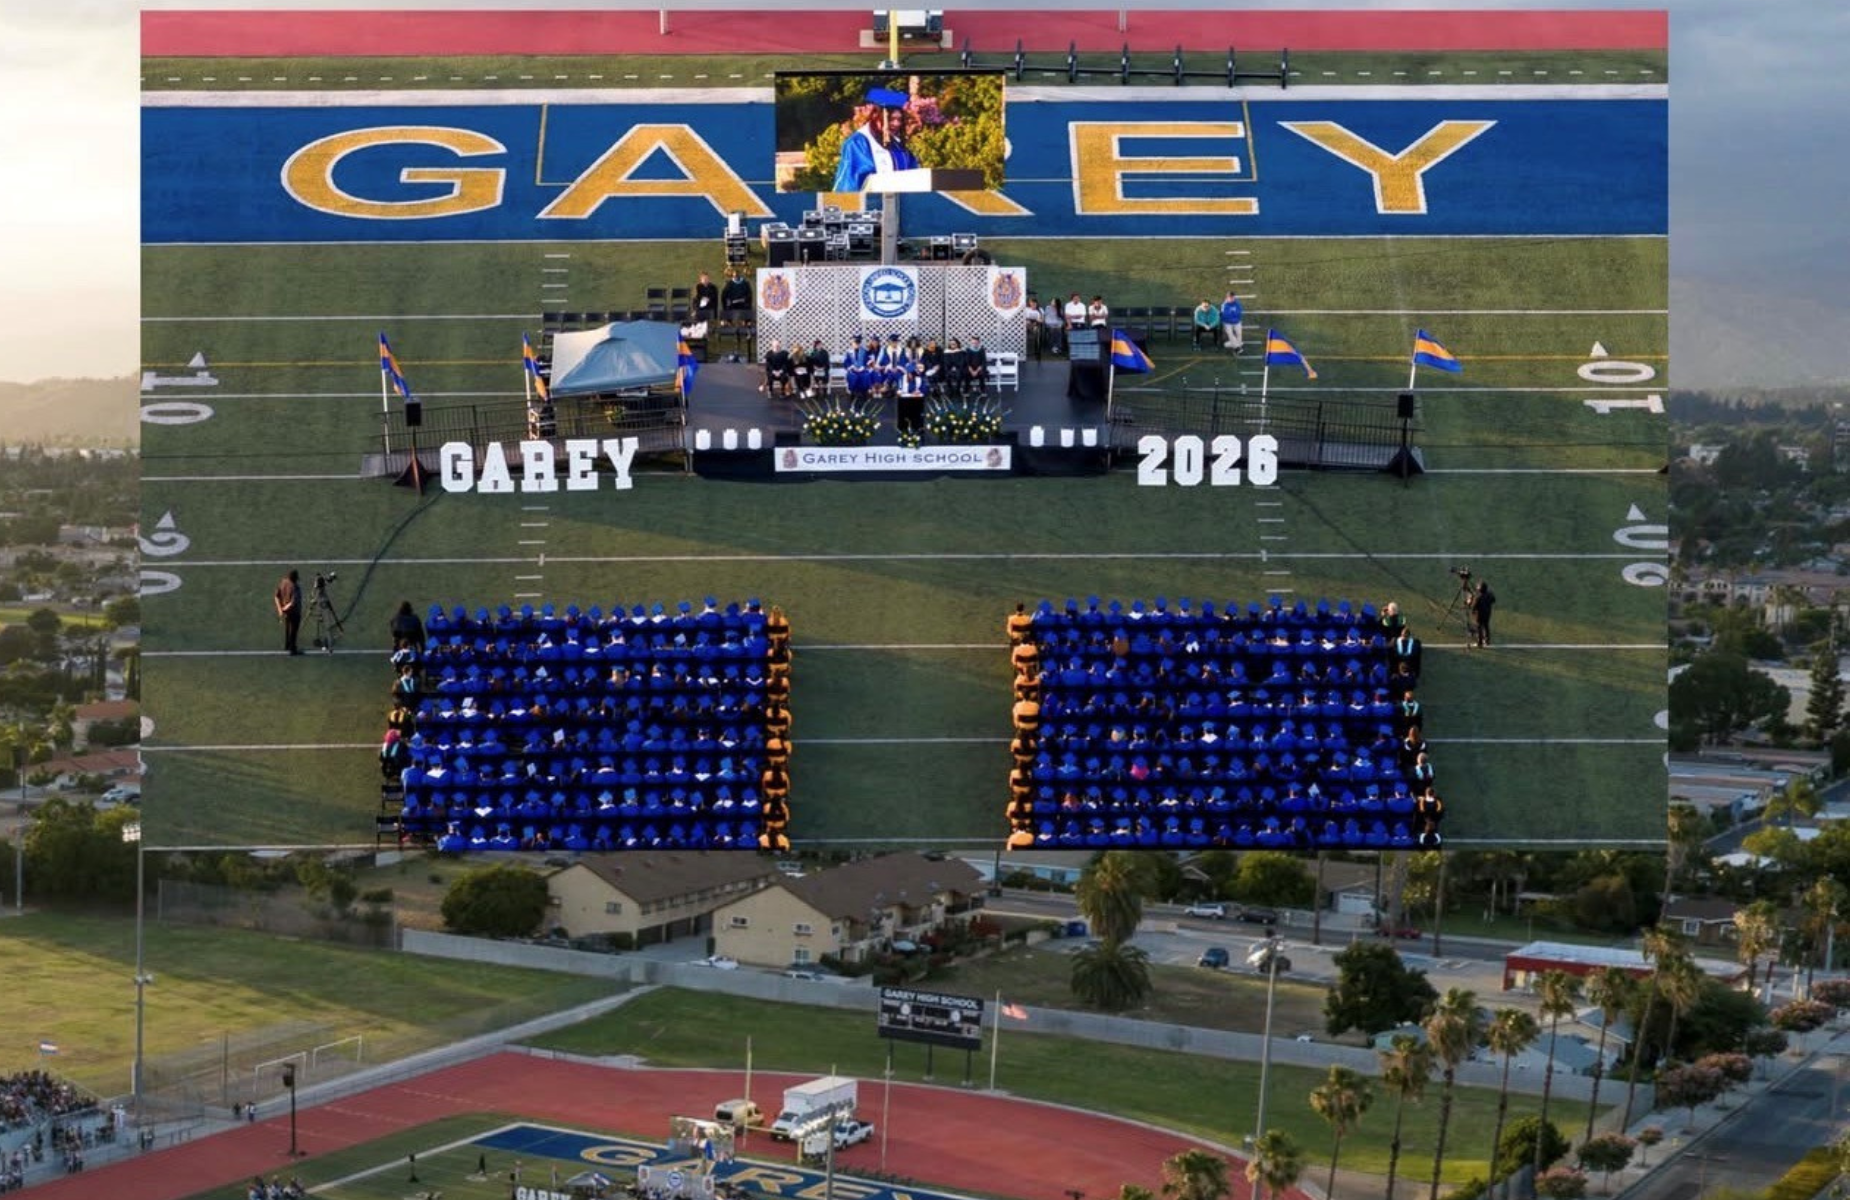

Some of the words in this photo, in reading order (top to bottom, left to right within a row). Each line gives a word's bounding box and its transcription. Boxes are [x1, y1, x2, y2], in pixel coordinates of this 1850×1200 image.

[279, 117, 1499, 220] GAEY
[440, 436, 640, 493] GAREY
[1137, 434, 1279, 486] 2026
